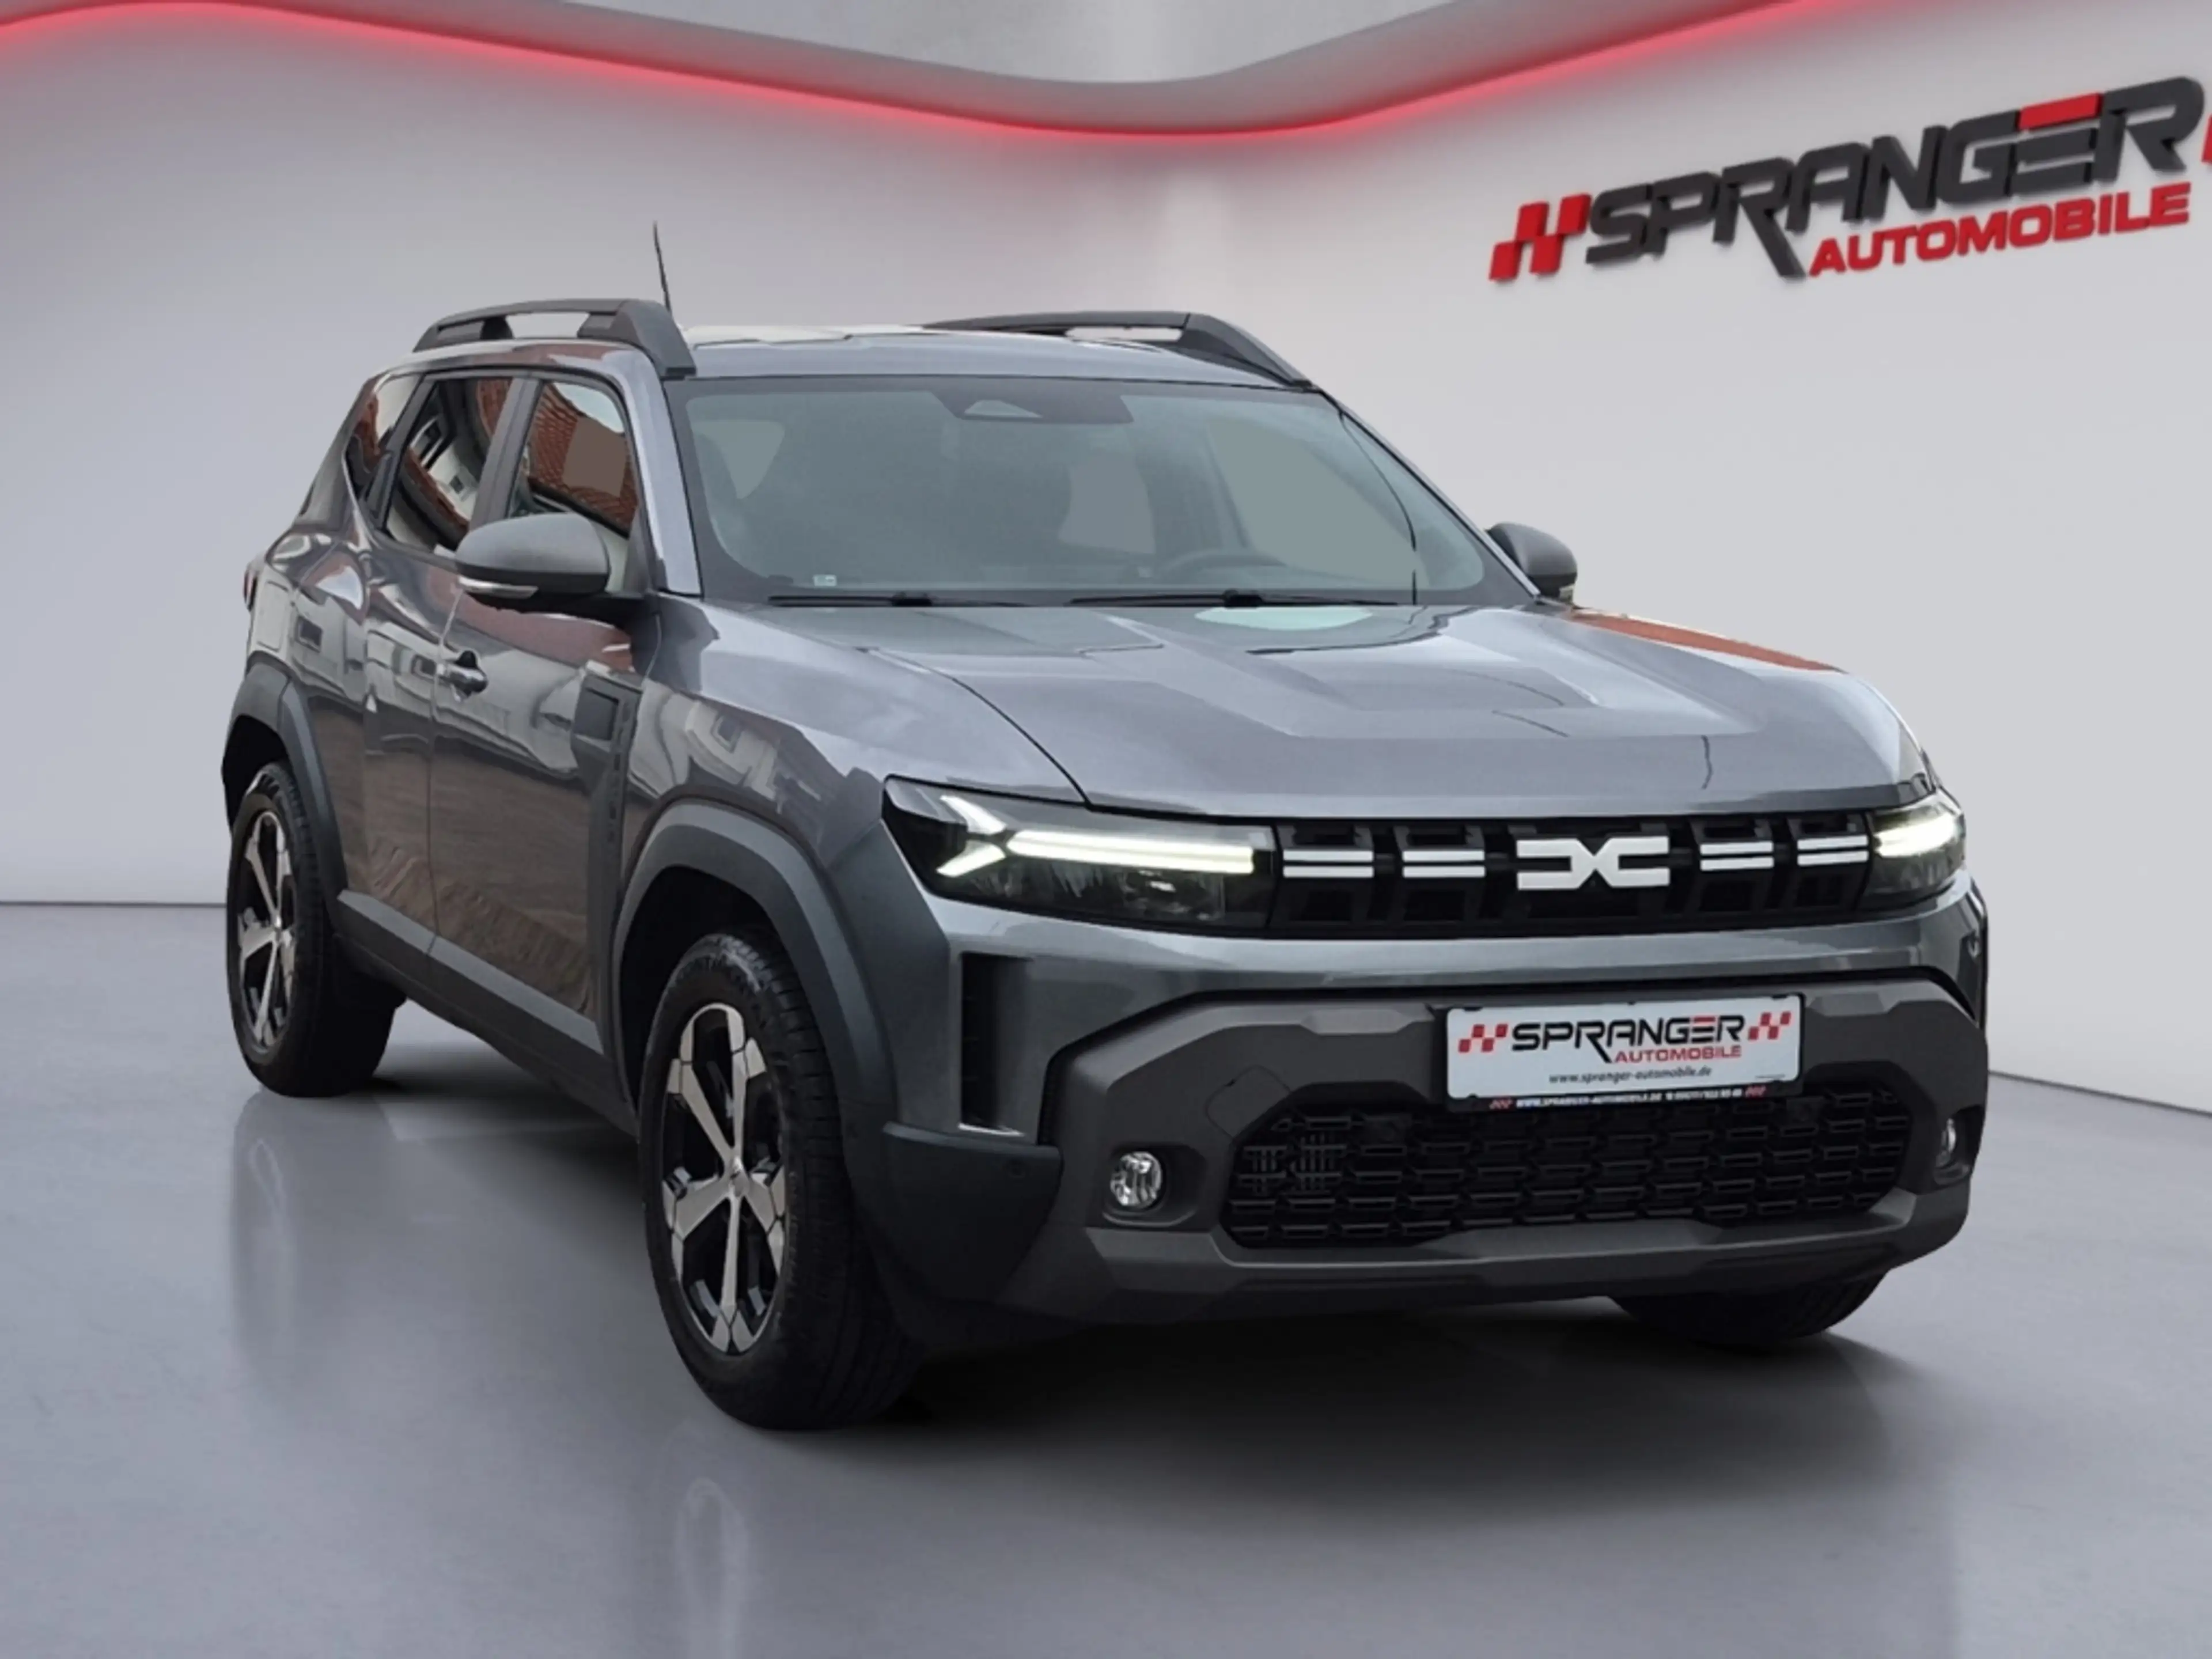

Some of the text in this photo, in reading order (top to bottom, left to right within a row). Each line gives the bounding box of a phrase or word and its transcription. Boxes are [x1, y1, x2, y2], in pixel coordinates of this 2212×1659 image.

[1585, 76, 2205, 279] SPRANGER
[1809, 182, 2191, 277] AUTOMOBILE
[1512, 1014, 1745, 1063] SPRANGER
[1613, 1045, 1742, 1063] AUTOMOBILE
[1549, 1065, 1712, 1085] www.spranger-automobile.de
